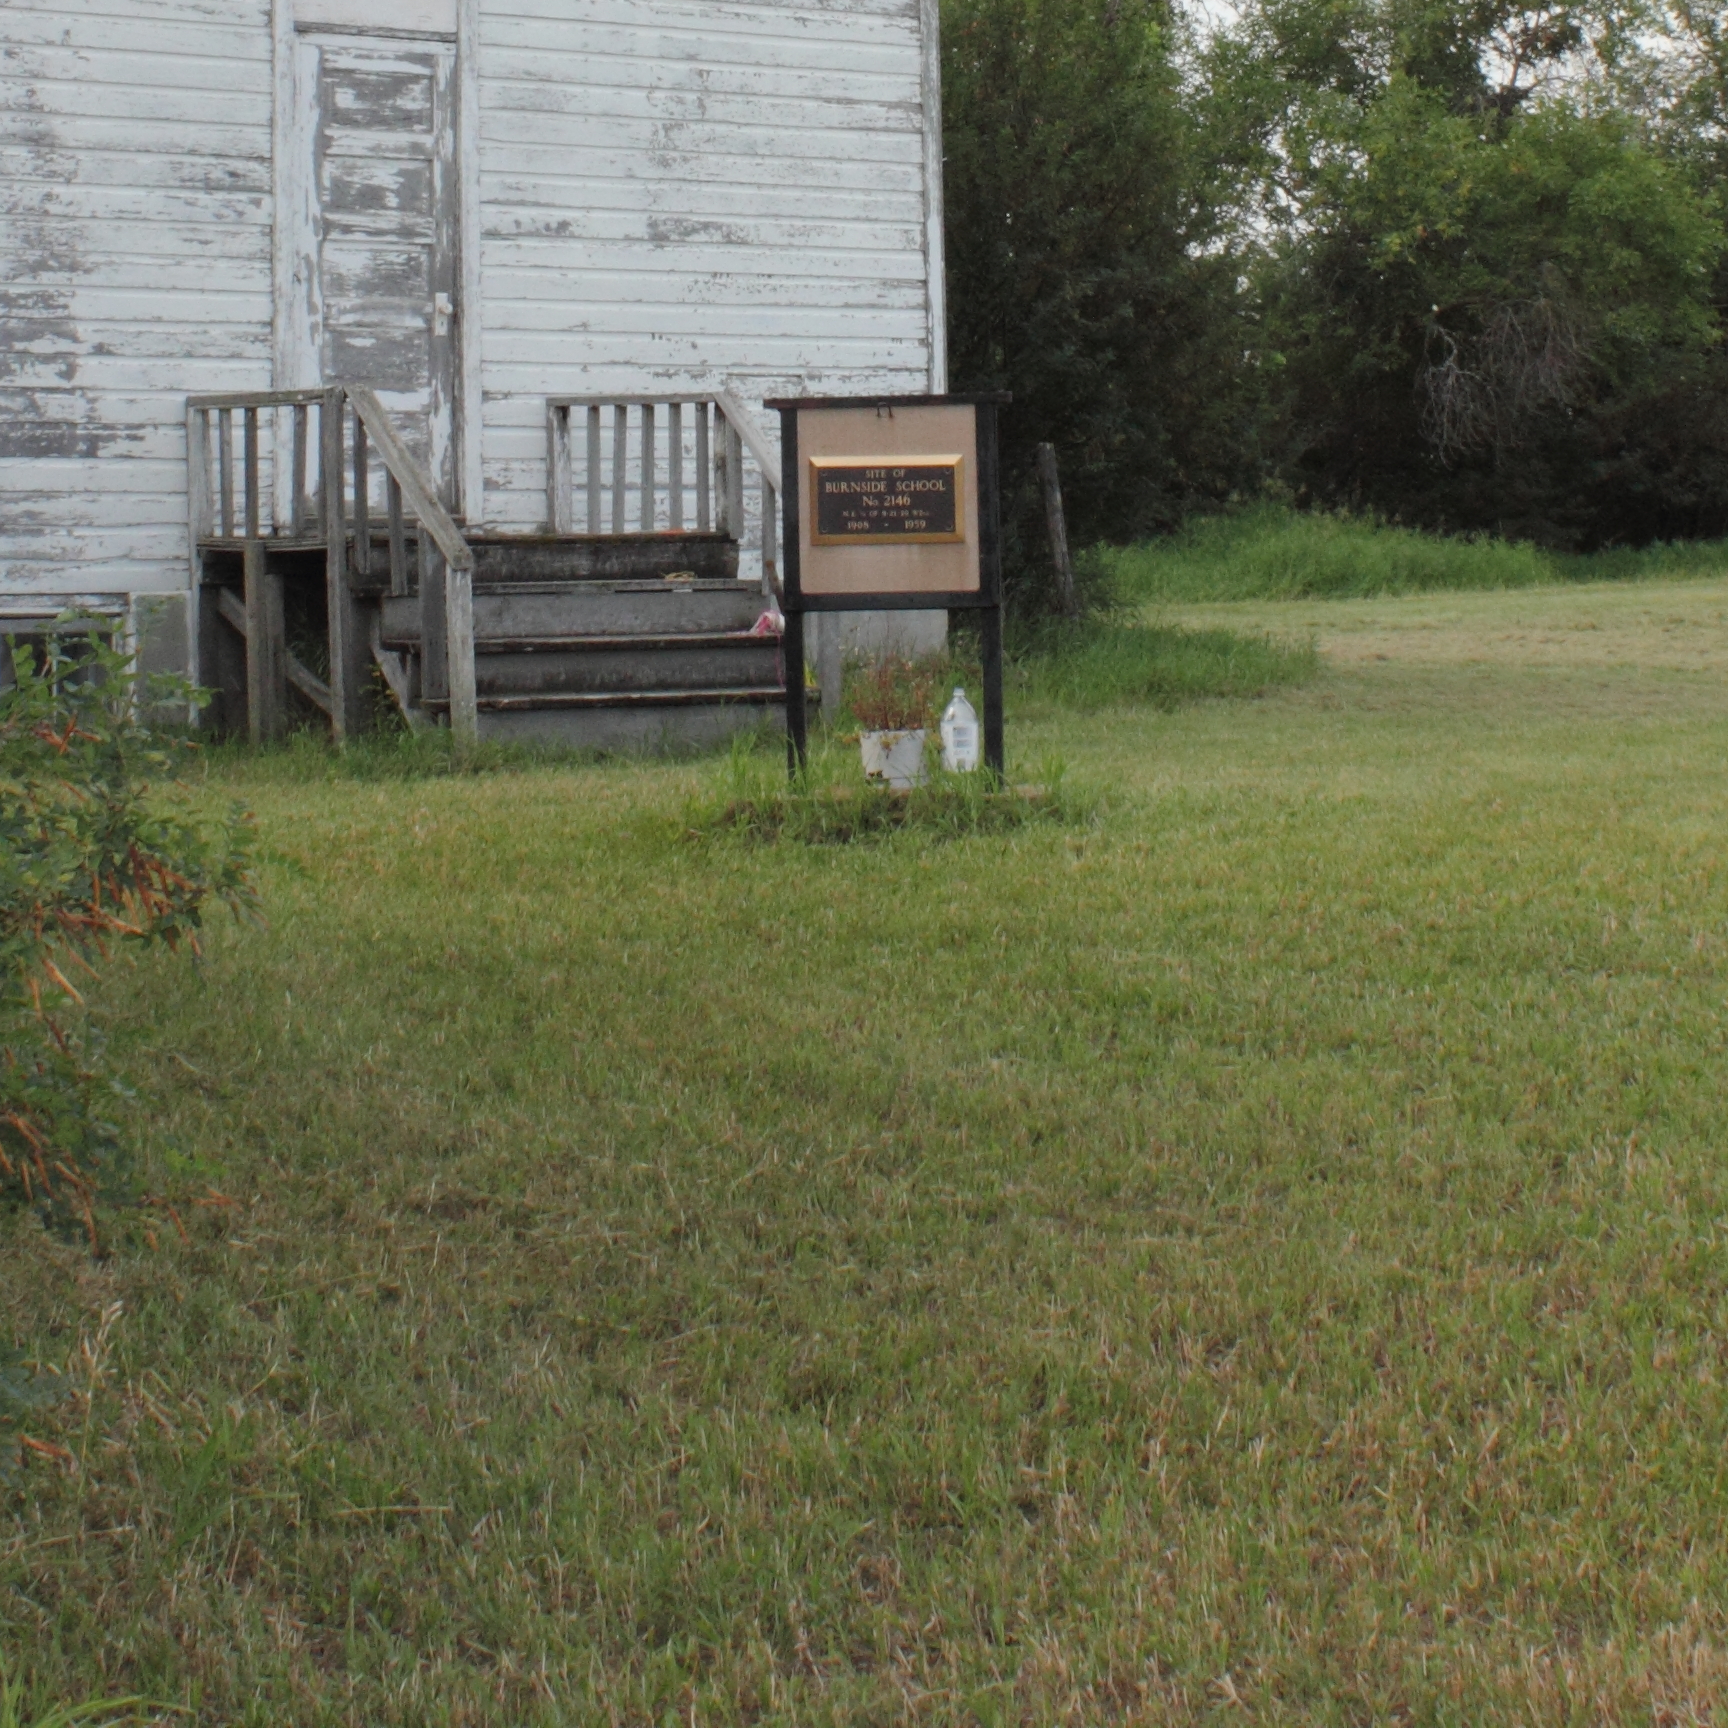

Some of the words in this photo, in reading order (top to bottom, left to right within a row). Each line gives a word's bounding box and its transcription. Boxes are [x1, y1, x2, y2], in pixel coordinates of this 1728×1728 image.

[866, 470, 886, 478] SITE
[893, 469, 905, 477] OF
[825, 481, 887, 492] BURNSIDE
[896, 480, 945, 491] SCHOOL
[883, 494, 911, 506] 2146
[905, 520, 926, 529] 1959
